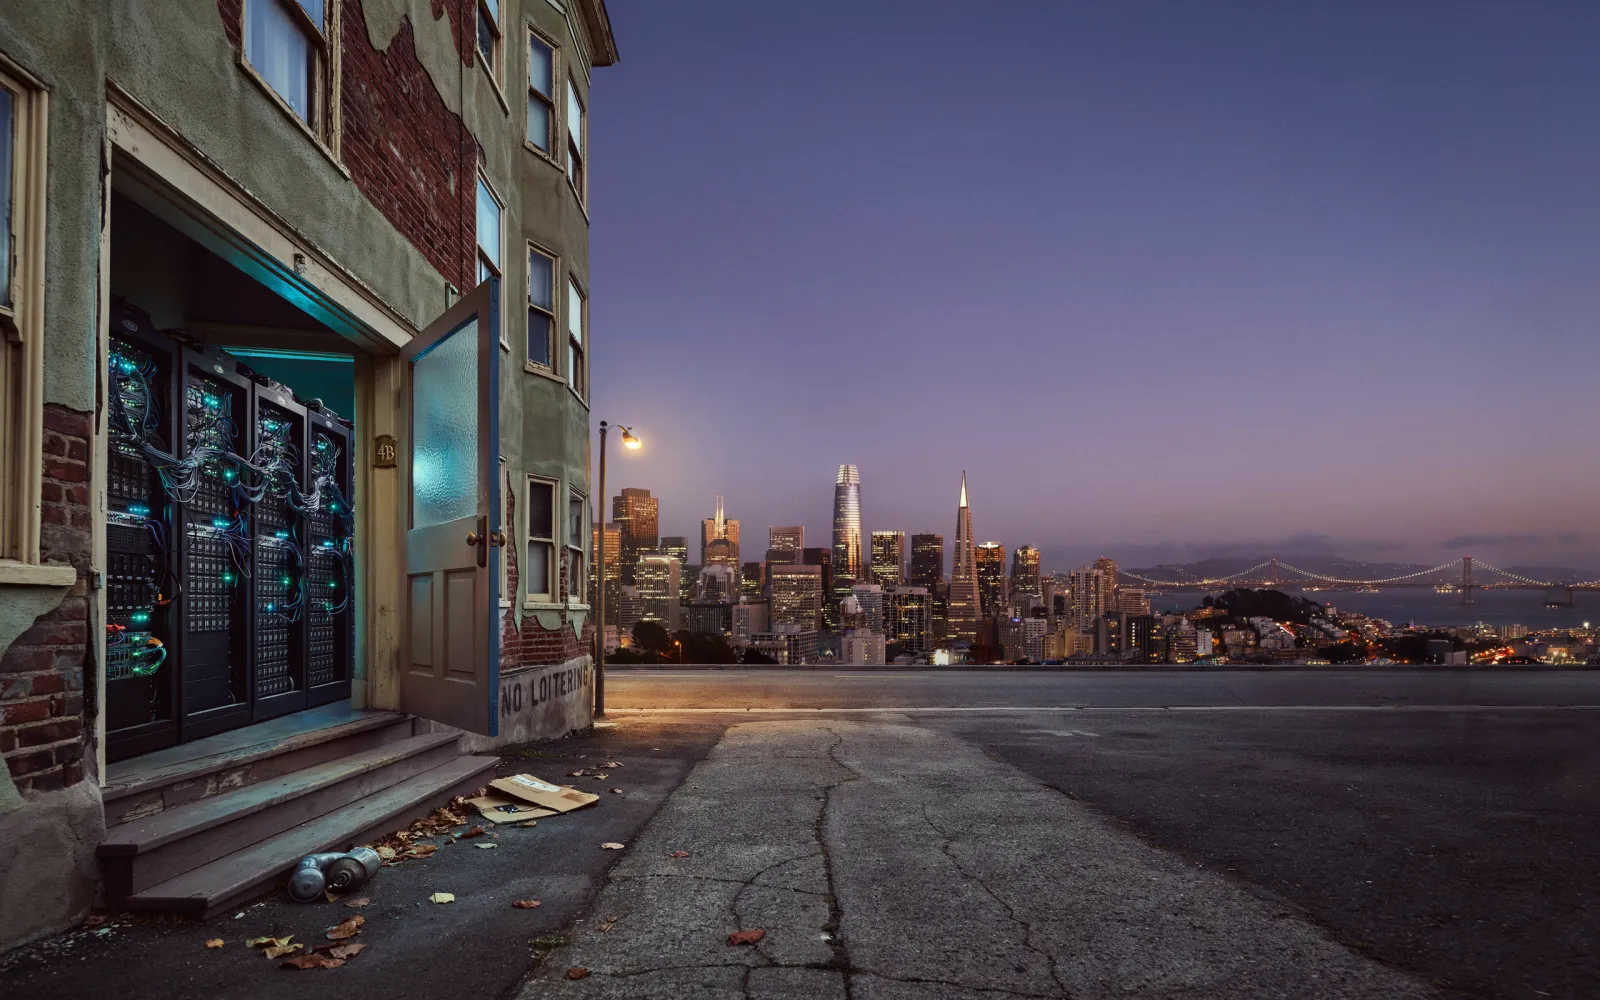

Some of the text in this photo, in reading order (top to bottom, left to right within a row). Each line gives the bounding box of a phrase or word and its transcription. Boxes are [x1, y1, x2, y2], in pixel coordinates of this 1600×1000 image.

[377, 444, 395, 460] 4B
[501, 665, 588, 718] NO LOITERING
